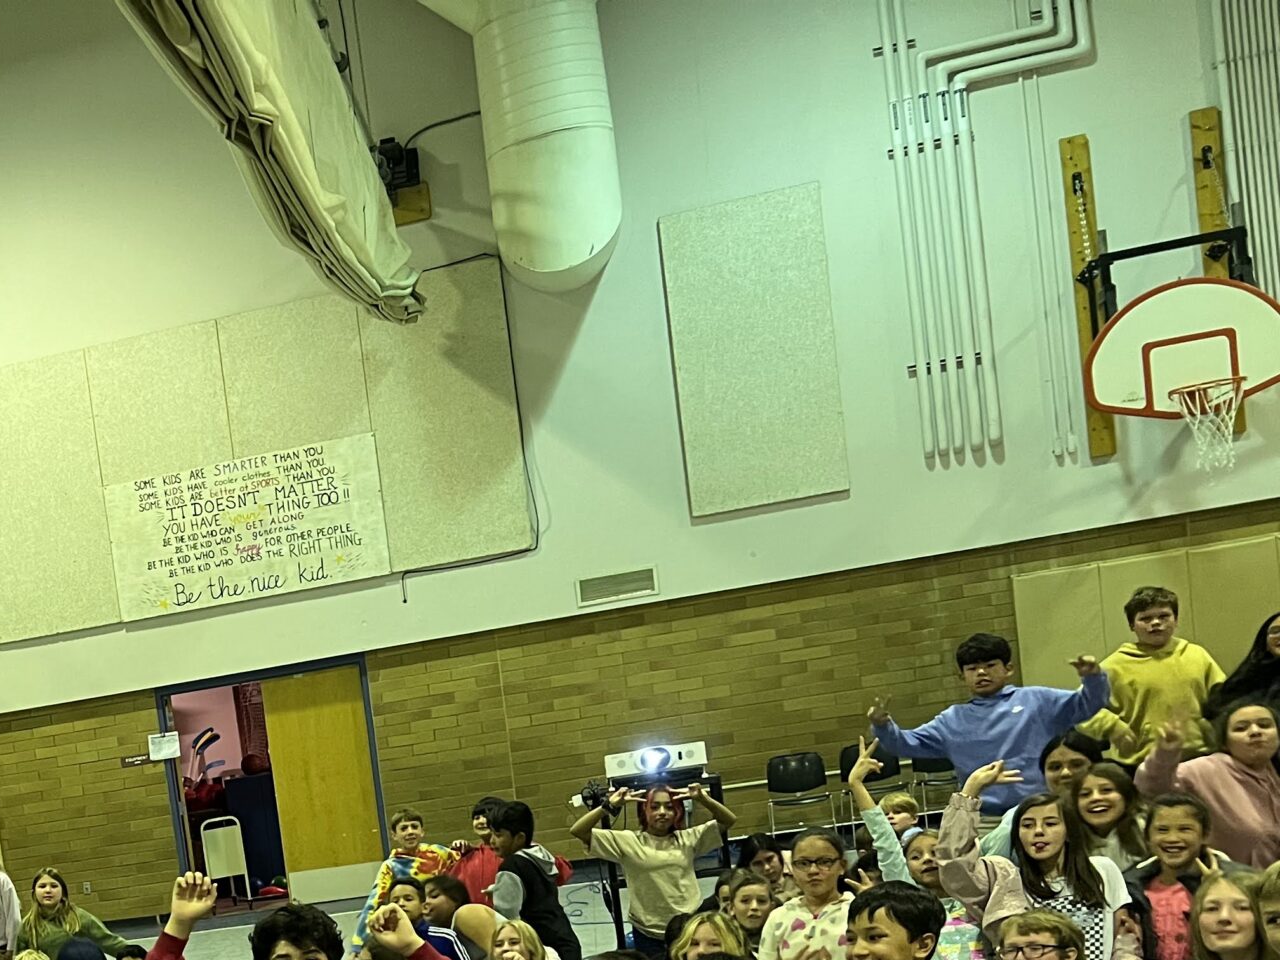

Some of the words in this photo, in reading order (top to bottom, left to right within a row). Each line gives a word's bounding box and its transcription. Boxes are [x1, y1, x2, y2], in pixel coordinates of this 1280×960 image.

[134, 477, 157, 491] SOME
[162, 473, 182, 486] KIDS
[189, 468, 207, 481] ARE
[213, 456, 267, 476] SMARTER
[273, 450, 300, 464] THAN
[303, 445, 324, 458] YOU
[138, 491, 159, 502] SOME
[164, 486, 184, 497] KIDS
[187, 481, 208, 492] HAVE
[214, 476, 238, 487] cooler
[241, 470, 271, 481] clothes
[276, 461, 303, 475] THAN
[306, 457, 325, 468] YOU
[138, 499, 162, 512] SOME
[165, 495, 185, 507] KIDS
[189, 491, 204, 502] ARE
[209, 486, 236, 498] better
[251, 477, 280, 490] SPORTS
[285, 470, 313, 484] THAN
[316, 465, 336, 478] YOU
[162, 521, 186, 537] YOU
[190, 513, 222, 531] HAVE
[265, 495, 312, 516] THING
[313, 490, 339, 508] TOO
[166, 504, 187, 522] IT
[274, 476, 338, 501] MATTER
[147, 560, 157, 571] BE
[159, 558, 174, 568] THE
[177, 555, 191, 565] KID
[193, 550, 215, 561] WHO
[220, 546, 229, 557] IS
[265, 537, 283, 547] FOR
[285, 530, 314, 544] OTHER
[316, 522, 352, 538] PEOPLE
[162, 538, 173, 547] BE
[174, 536, 186, 544] THE
[187, 532, 199, 541] KID
[200, 529, 218, 539] WHO
[219, 525, 235, 536] CAN
[245, 519, 264, 531] GET
[270, 511, 305, 526] ALONG
[174, 545, 184, 554] BE
[185, 542, 199, 551] THE
[199, 540, 213, 549] KID
[215, 536, 232, 546] WHO
[234, 533, 243, 542] IS
[252, 524, 297, 541] generous
[168, 569, 179, 578] BE
[181, 565, 196, 575] THE
[197, 562, 211, 572] KID
[214, 558, 234, 568] WHO
[240, 553, 263, 564] DOES
[266, 548, 285, 559] THE
[289, 538, 322, 558] RIGHT
[328, 532, 363, 550] THING
[172, 583, 202, 606] Be
[207, 575, 246, 600] the
[250, 572, 286, 594] nice
